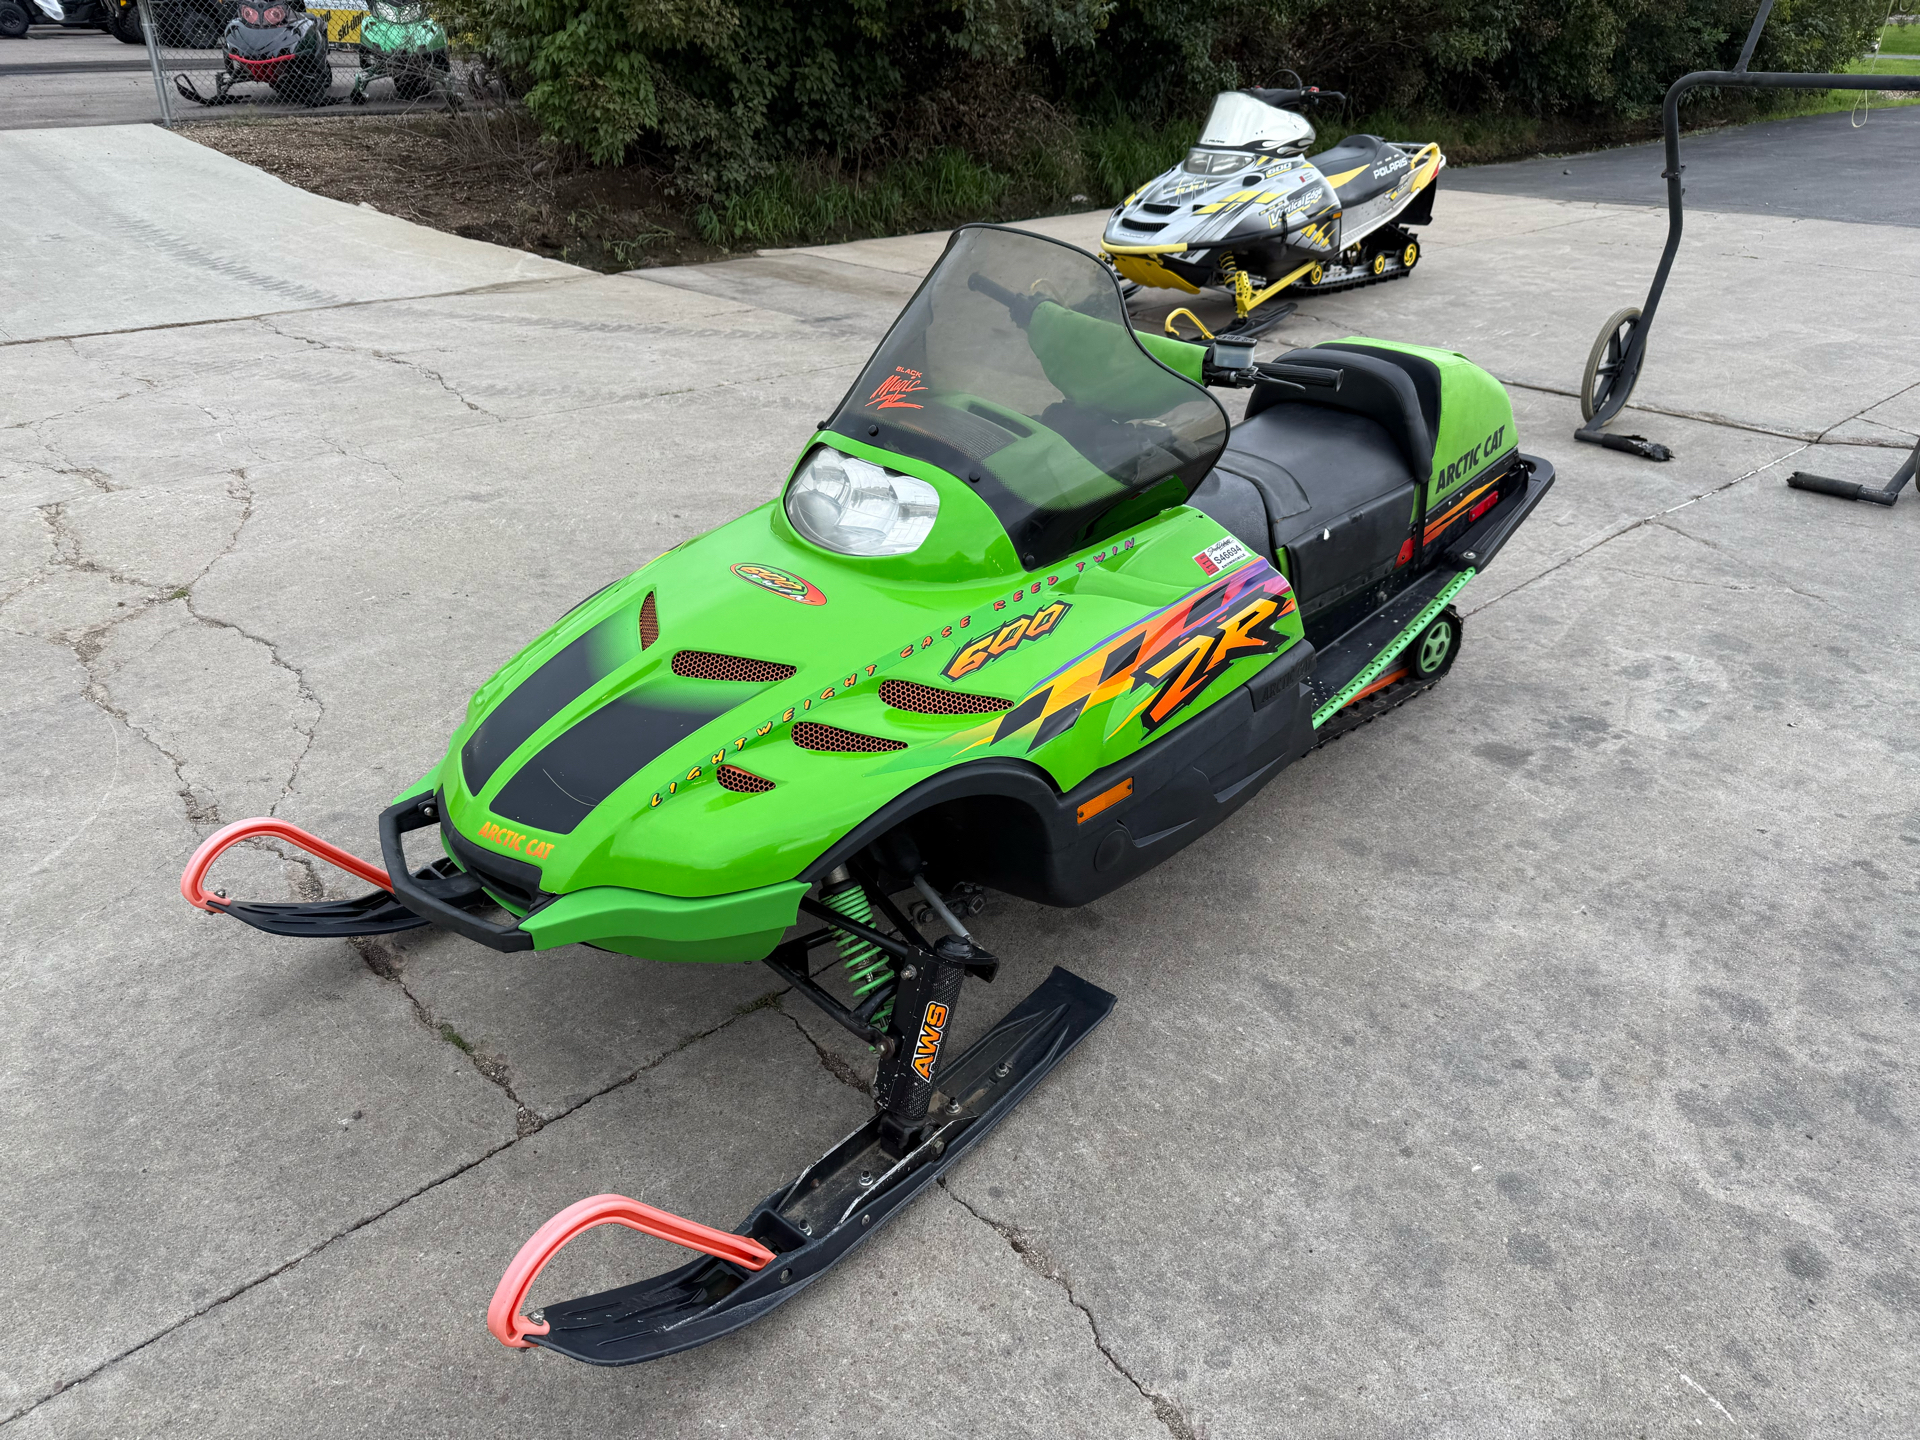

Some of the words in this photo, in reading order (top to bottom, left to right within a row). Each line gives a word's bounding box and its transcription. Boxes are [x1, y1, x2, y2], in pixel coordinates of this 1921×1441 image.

[1266, 162, 1292, 177] 600
[1373, 157, 1408, 180] POLARIS
[1304, 186, 1323, 206] Edge
[895, 365, 923, 378] BLACK
[869, 375, 929, 403] Magic
[1435, 442, 1482, 495] ARCTIC
[1484, 424, 1505, 458] CAT
[1213, 544, 1242, 565] S46694
[737, 565, 805, 592] 600
[942, 600, 1073, 681] 600
[650, 664, 877, 807] LIGHTWEIGHT
[900, 615, 971, 658] CASE
[993, 575, 1058, 611] REED
[1076, 537, 1136, 572] TWIN
[1138, 592, 1284, 730] ZR
[1261, 667, 1295, 703] ARCTIC
[477, 821, 526, 851] ARCTIC
[526, 839, 555, 860] CAT
[912, 1002, 948, 1081] AWS
